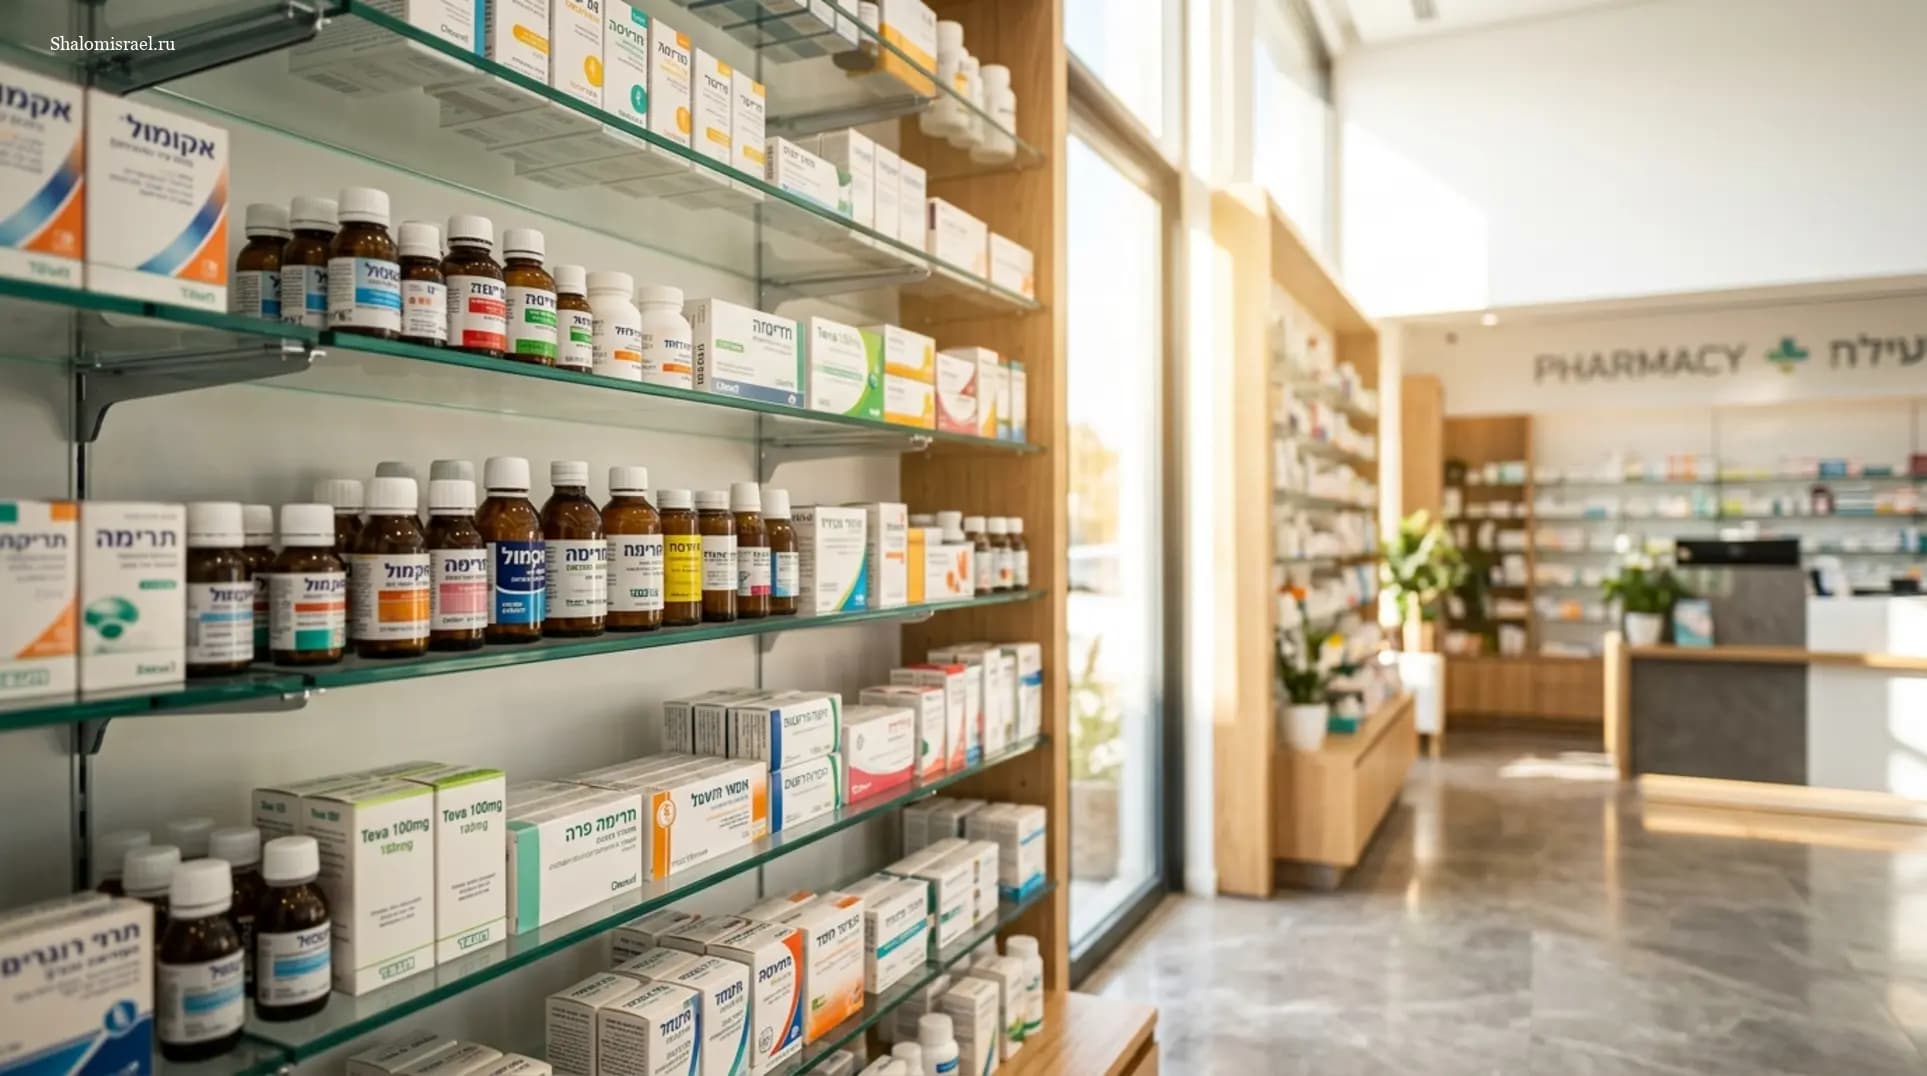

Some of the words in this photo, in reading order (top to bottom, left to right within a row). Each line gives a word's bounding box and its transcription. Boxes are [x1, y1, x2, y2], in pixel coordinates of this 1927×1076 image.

[1534, 343, 1747, 383] PHARMACY
[96, 529, 177, 548] תרימה
[471, 799, 503, 816] 100mg
[361, 827, 389, 844] Teva
[393, 818, 430, 837] 100mg
[565, 821, 593, 842] פרה
